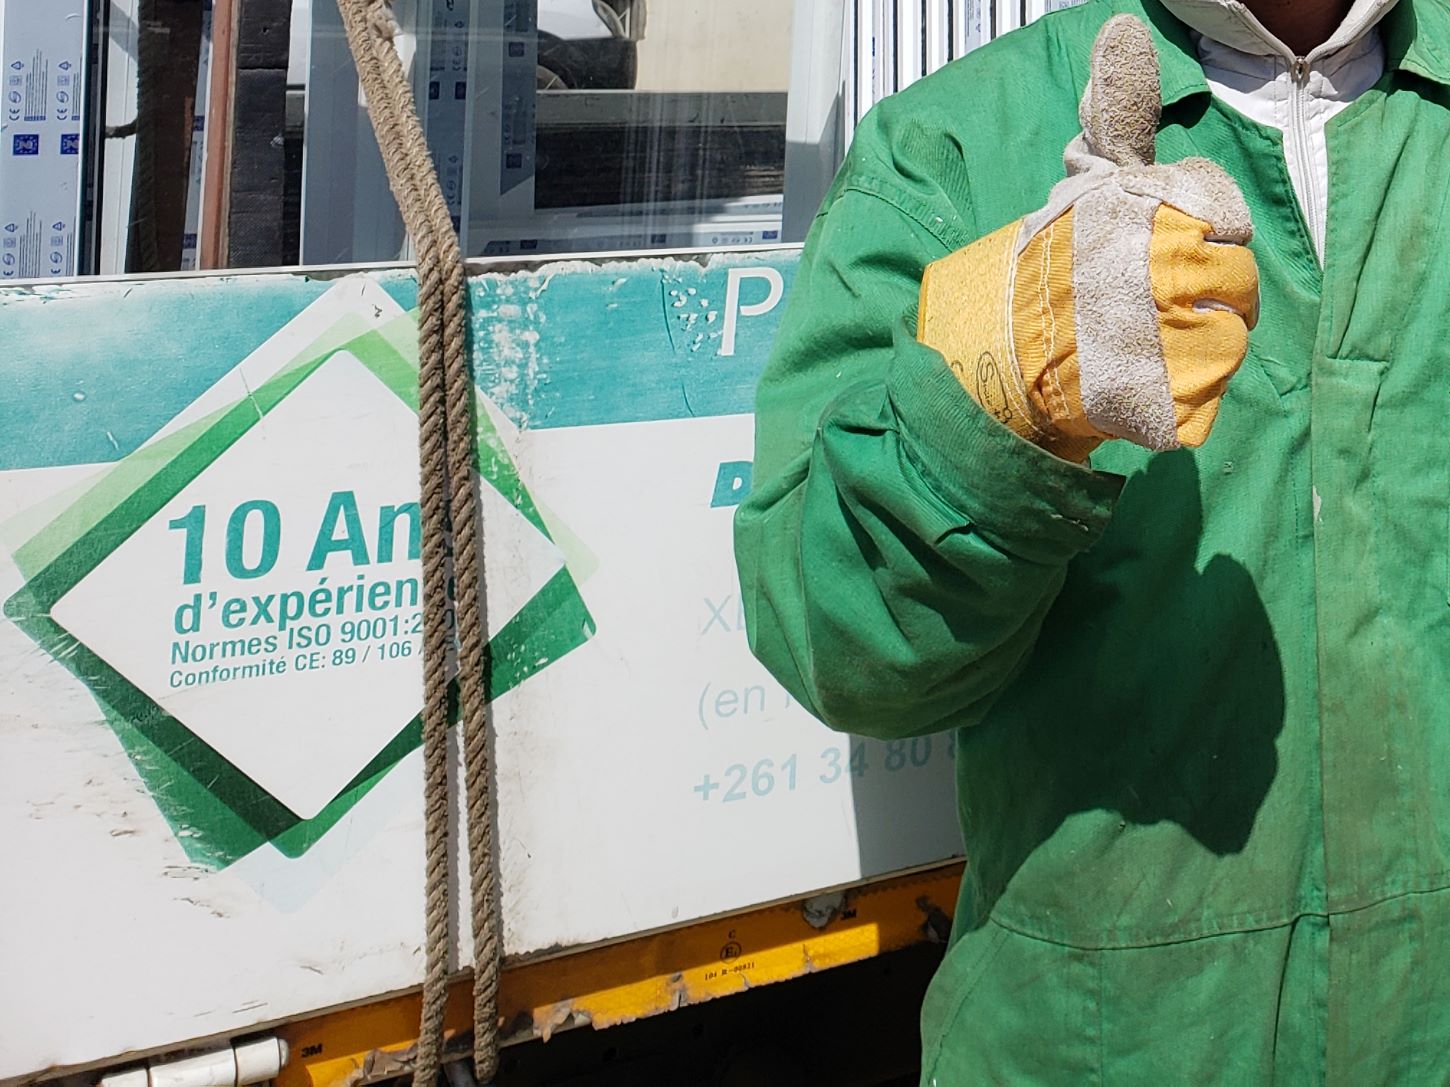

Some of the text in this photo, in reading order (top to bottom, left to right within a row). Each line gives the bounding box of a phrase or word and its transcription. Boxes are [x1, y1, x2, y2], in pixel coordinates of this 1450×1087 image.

[168, 499, 281, 585] 10
[169, 655, 287, 689] Conformité
[294, 651, 327, 673] CE:
[332, 646, 356, 667] 89
[377, 638, 413, 661] 106
[170, 632, 279, 666] Normes
[287, 623, 332, 651] ISO
[693, 753, 798, 803] +261
[818, 741, 870, 785] 34
[883, 735, 932, 772] 80
[301, 1043, 323, 1058] 3M
